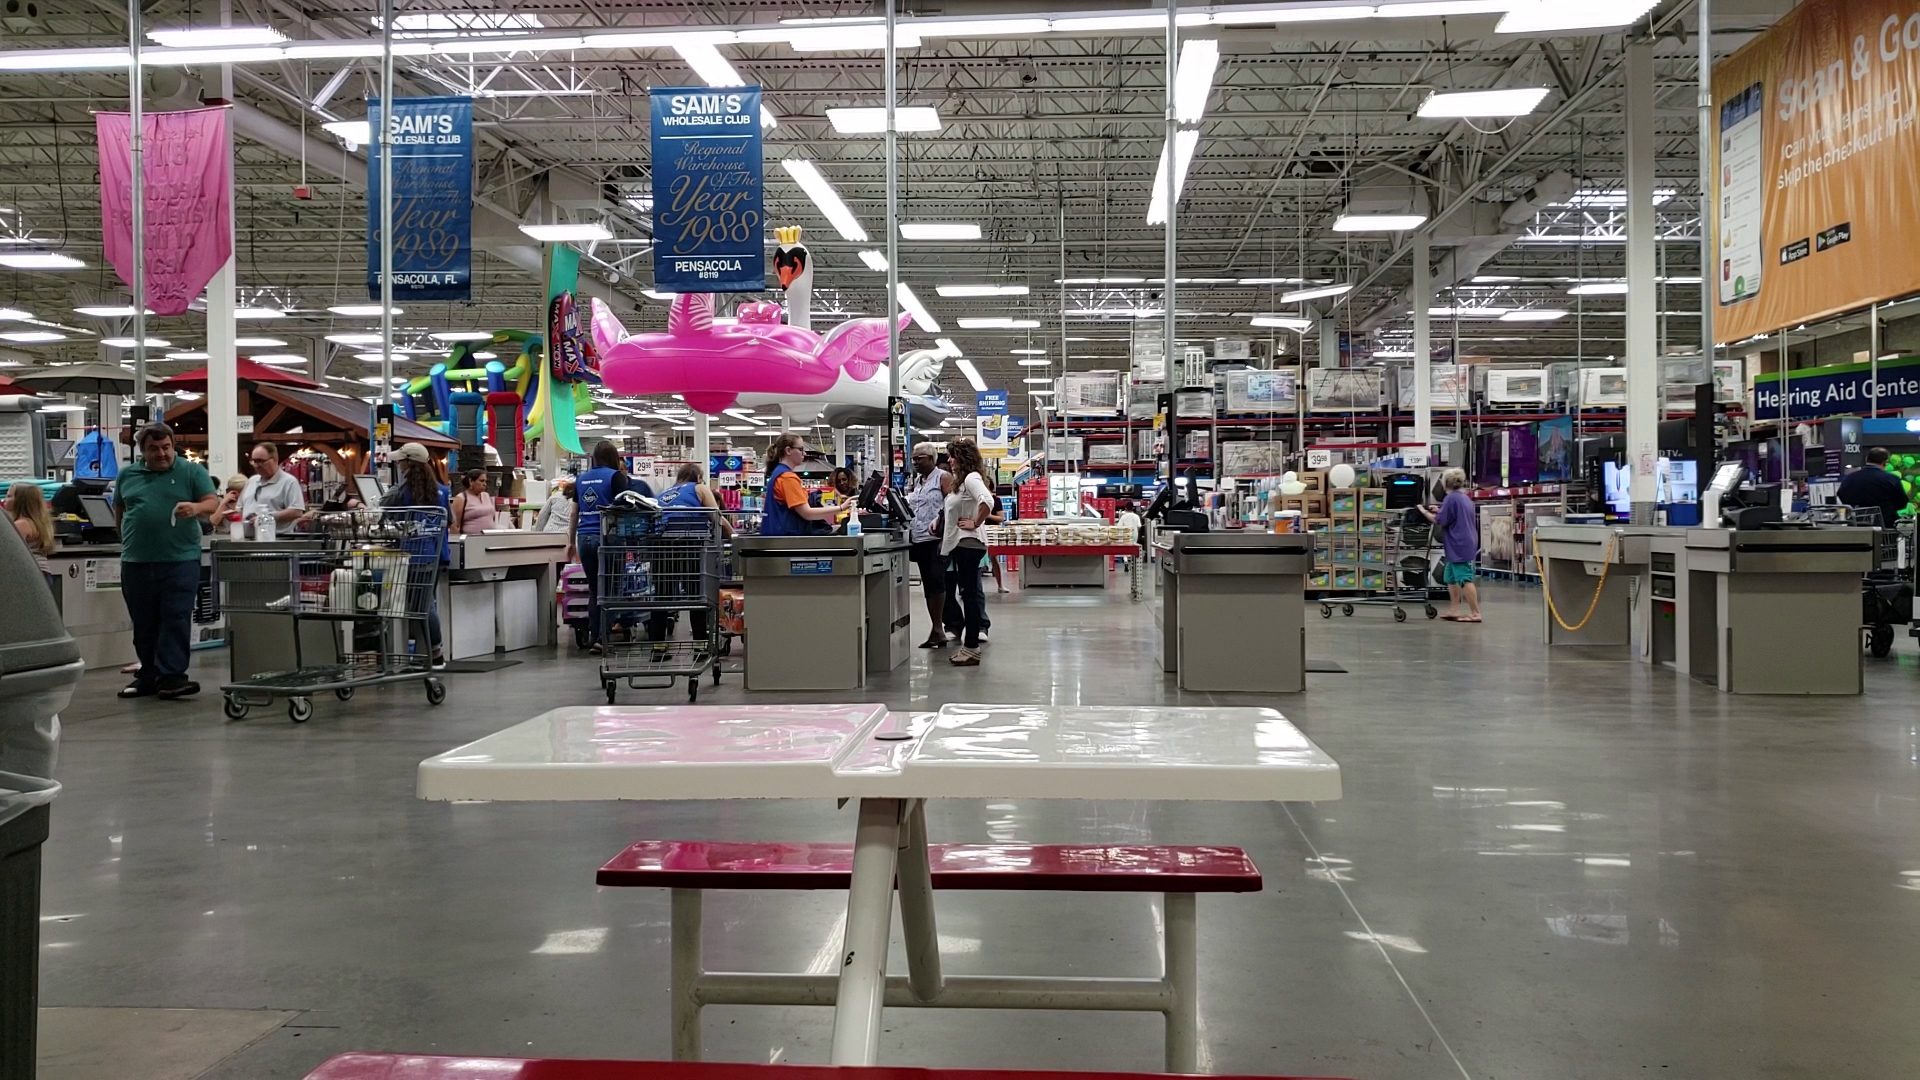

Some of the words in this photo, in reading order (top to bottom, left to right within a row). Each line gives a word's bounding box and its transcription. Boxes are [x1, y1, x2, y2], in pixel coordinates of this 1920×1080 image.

[1779, 59, 1845, 121] Scan
[1851, 34, 1870, 80] &
[1880, 12, 1920, 62] Go
[671, 95, 742, 115] SAM'S
[390, 115, 453, 134] SAM'S
[663, 116, 723, 126] WHOLESALE
[725, 115, 751, 125] CLUB
[436, 135, 461, 144] CLUB
[684, 140, 748, 160] Regional
[1778, 165, 1802, 190] skip
[1803, 156, 1822, 178] the
[1823, 123, 1882, 168] checkout
[397, 160, 456, 177] Regional
[674, 157, 745, 171] Warehouse
[710, 171, 731, 190] Of
[729, 171, 757, 186] The
[660, 174, 754, 226] Year
[673, 210, 759, 254] 1988
[392, 228, 460, 270] 1989
[675, 260, 742, 272] PENSACOLA
[698, 271, 719, 279] #8119
[444, 274, 458, 284] FL
[552, 303, 560, 340] MAX
[553, 342, 561, 368] WOW
[563, 341, 585, 375] MAX
[1758, 387, 1821, 408] Hearing
[1825, 380, 1856, 402] Aid
[1862, 377, 1920, 399] Cente
[1844, 444, 1860, 453] XBOX
